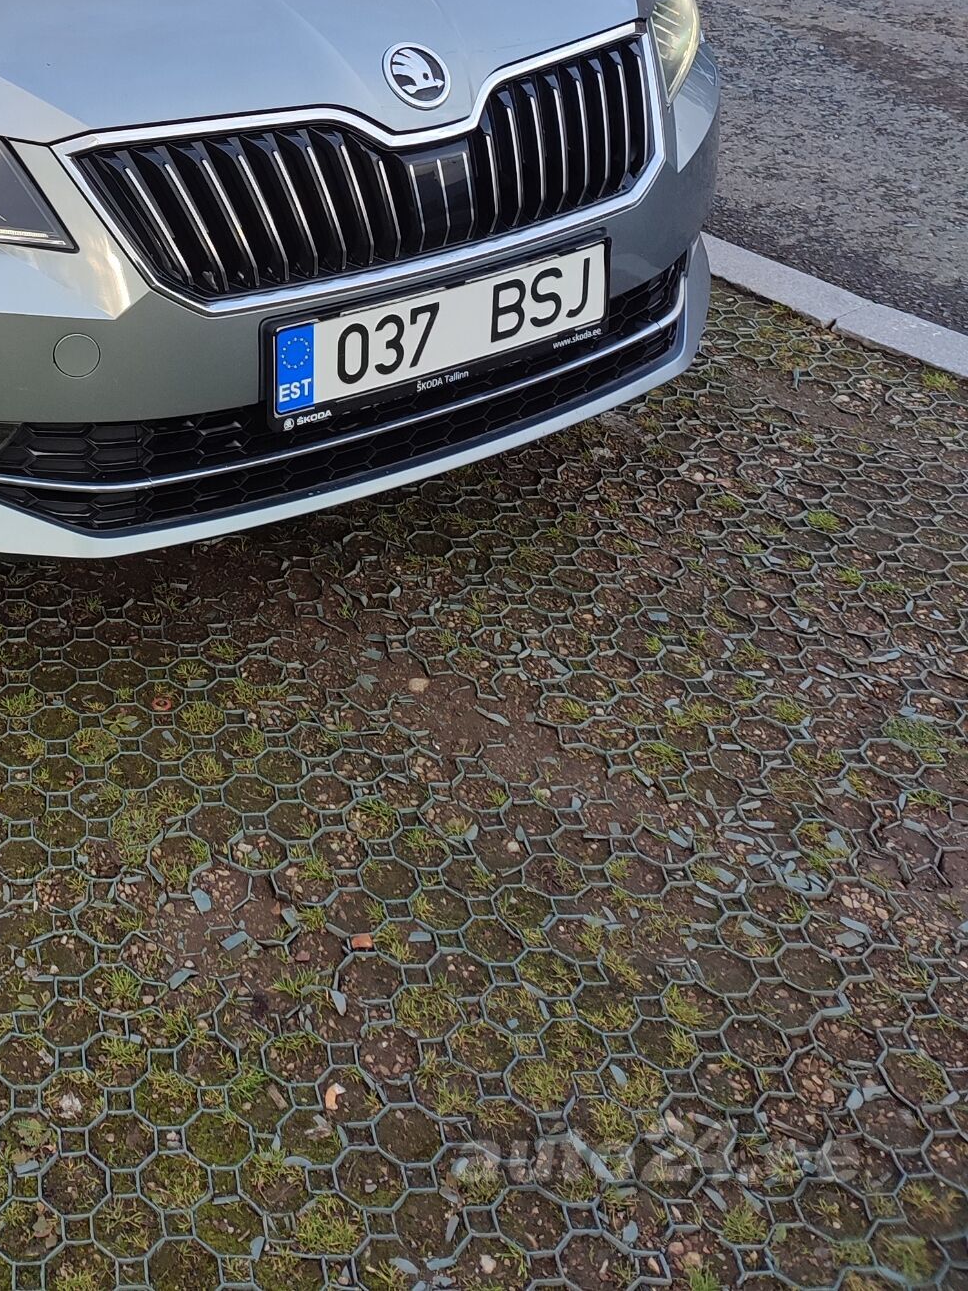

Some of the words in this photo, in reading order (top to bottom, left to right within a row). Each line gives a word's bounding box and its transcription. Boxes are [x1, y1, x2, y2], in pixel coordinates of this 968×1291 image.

[336, 301, 440, 385] 037
[490, 256, 591, 343] BSJ
[552, 327, 602, 350] www.skoda.ee
[278, 377, 313, 403] EST
[416, 377, 444, 393] ŠKODA
[444, 370, 469, 384] Tallinn
